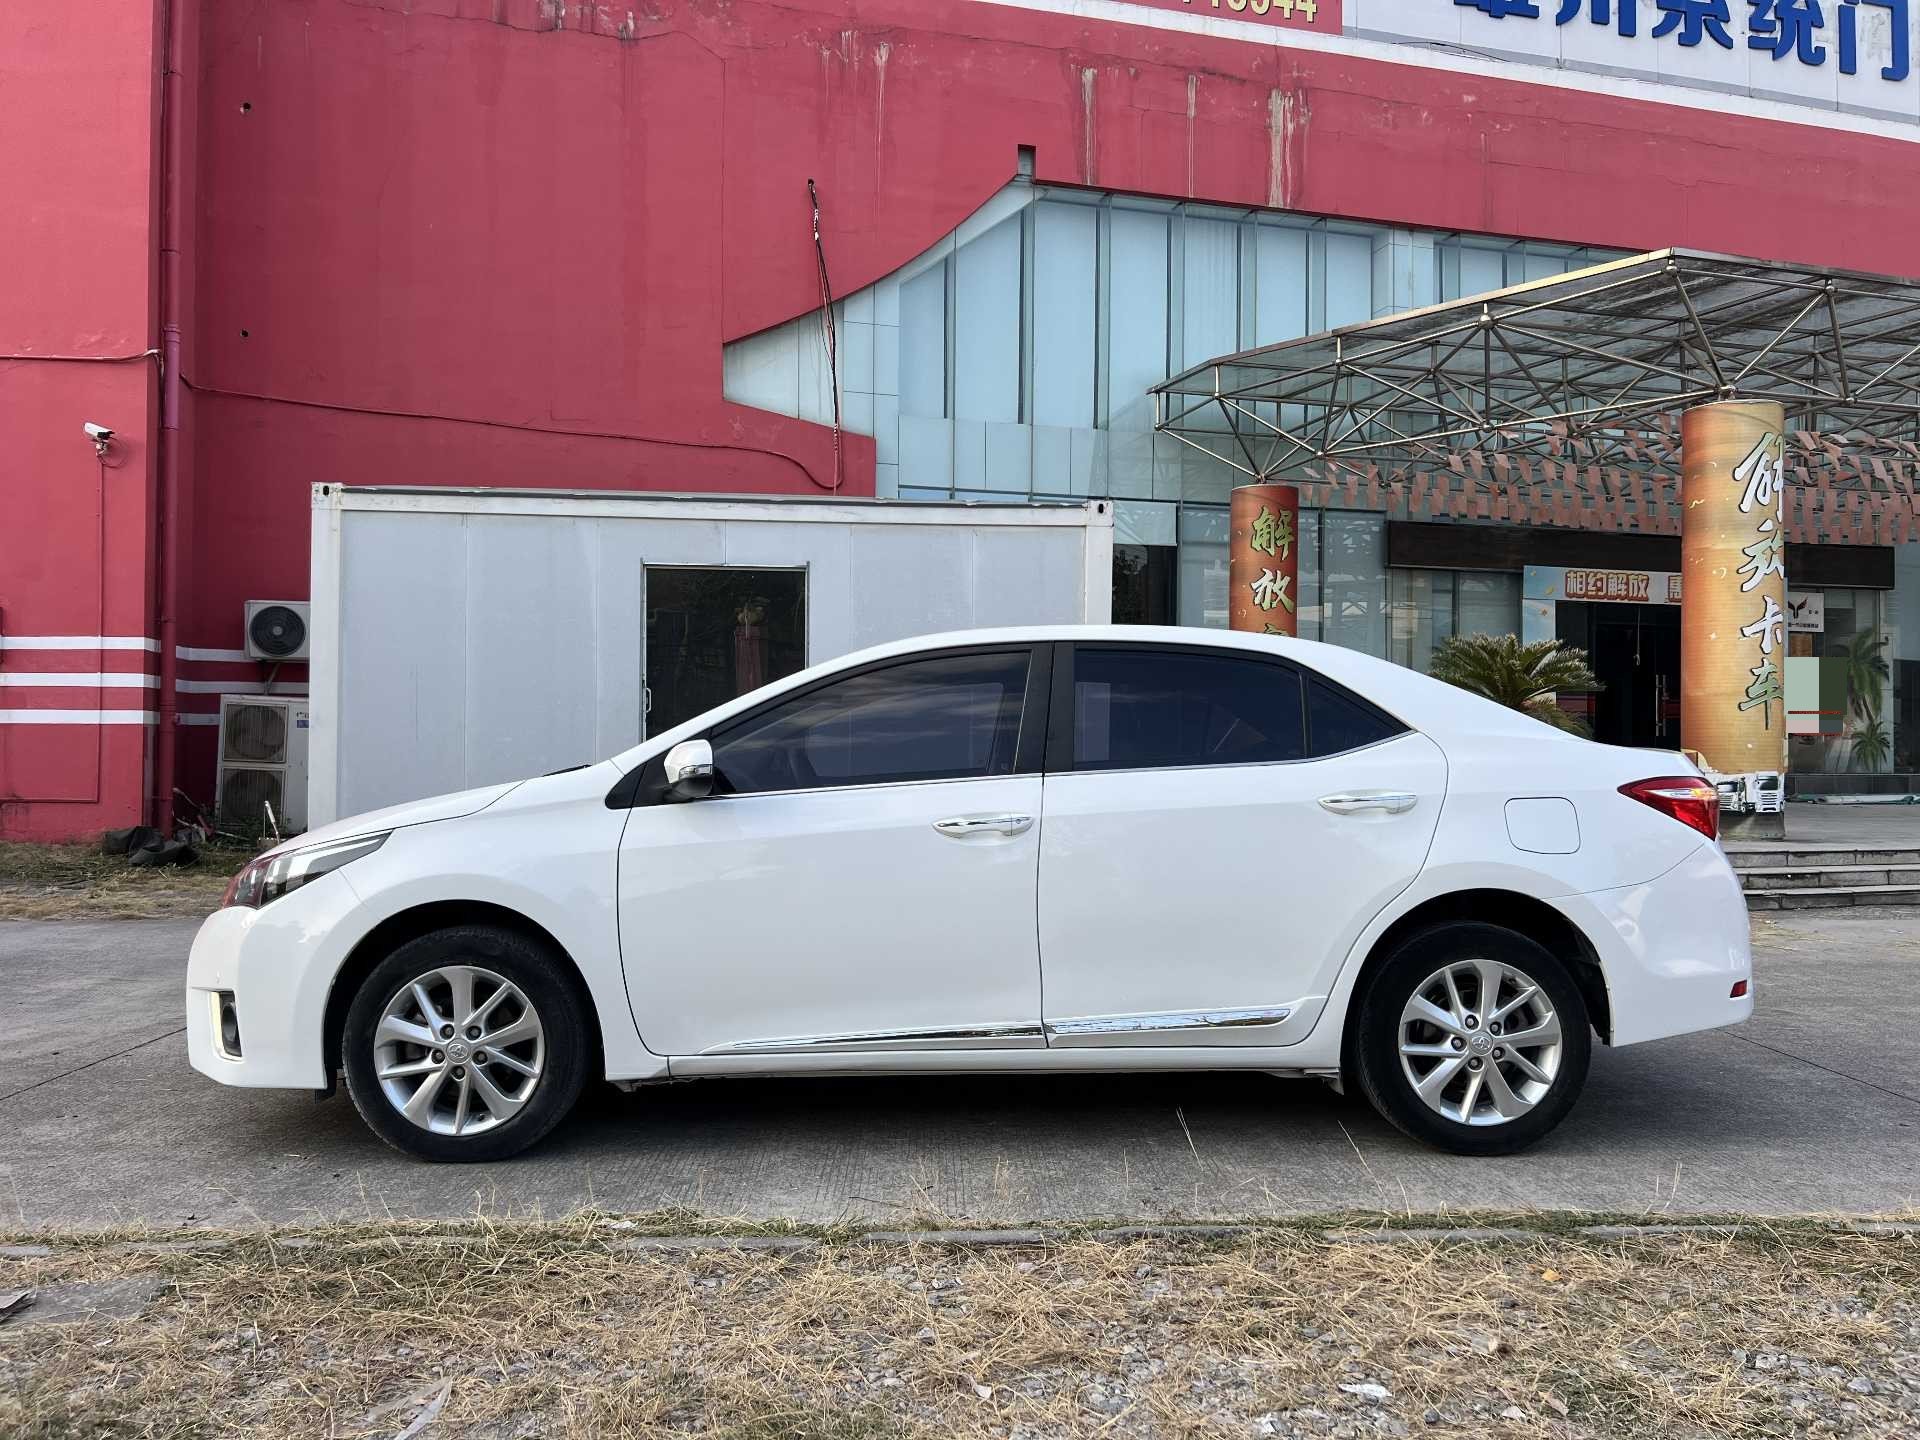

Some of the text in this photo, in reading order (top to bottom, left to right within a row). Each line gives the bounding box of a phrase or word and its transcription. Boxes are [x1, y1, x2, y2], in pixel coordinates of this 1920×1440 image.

[1250, 506, 1294, 637] 解放
[1566, 571, 1649, 600] 相约解放
